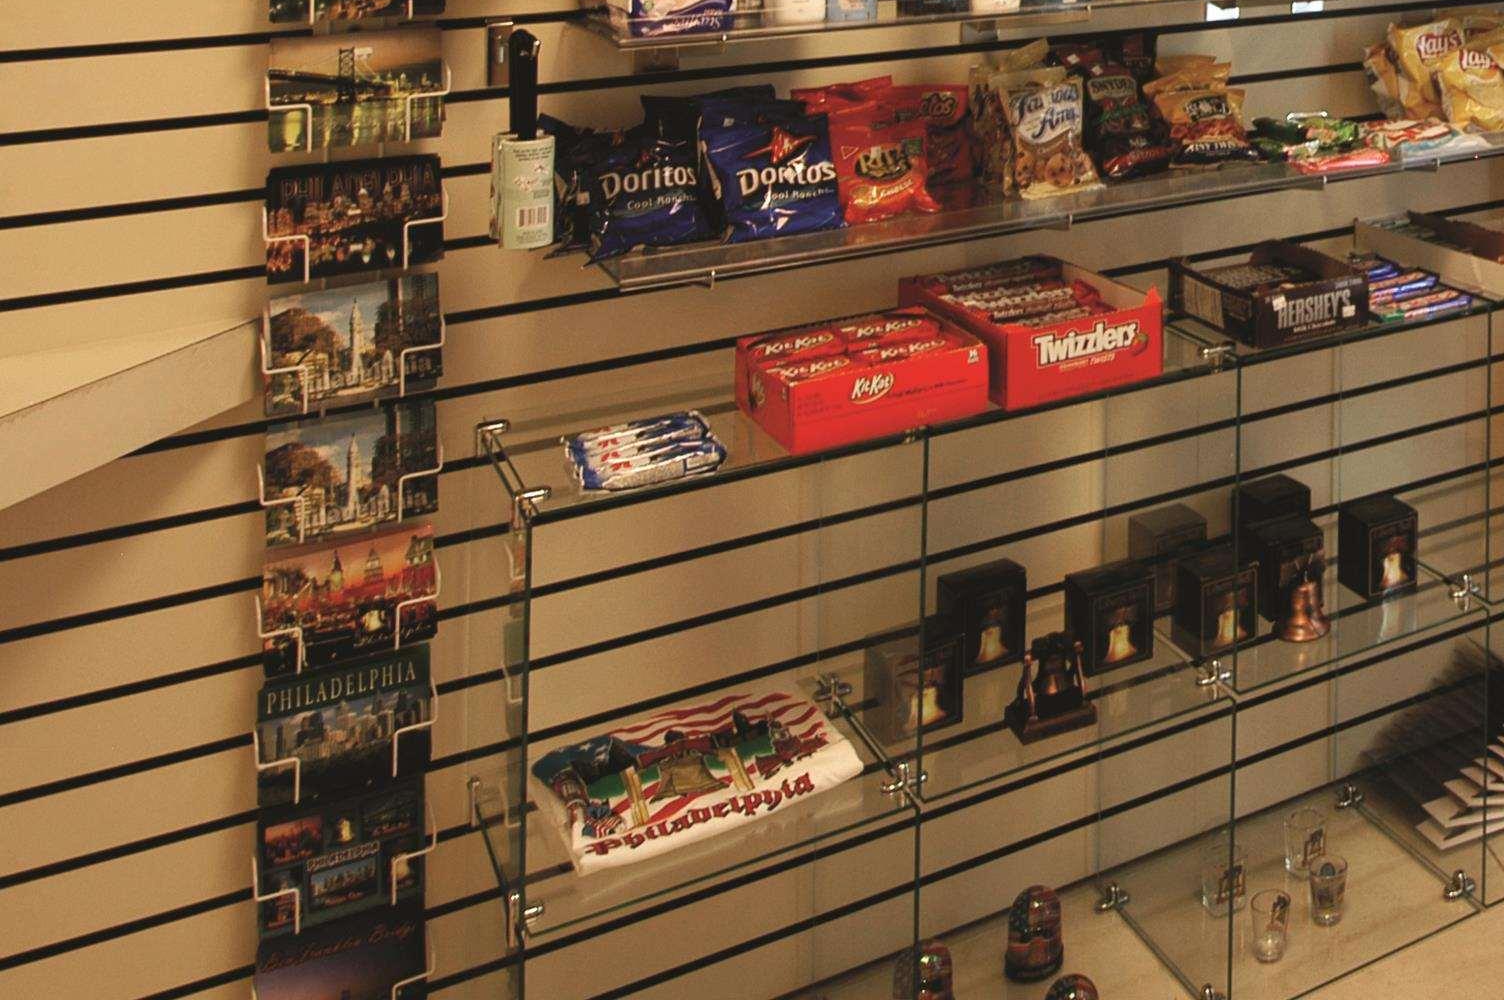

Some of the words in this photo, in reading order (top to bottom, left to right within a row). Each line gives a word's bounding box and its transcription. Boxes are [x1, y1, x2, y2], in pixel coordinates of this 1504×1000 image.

[1461, 50, 1494, 70] Lay
[599, 166, 697, 200] Doritos
[735, 161, 837, 198] Doritos
[626, 197, 653, 210] Cool
[1278, 289, 1351, 330] HERSHEY'S
[1034, 321, 1138, 366] Twizzlers
[266, 660, 417, 715] PHILADELPHIA
[584, 771, 816, 856] Philadelphia
